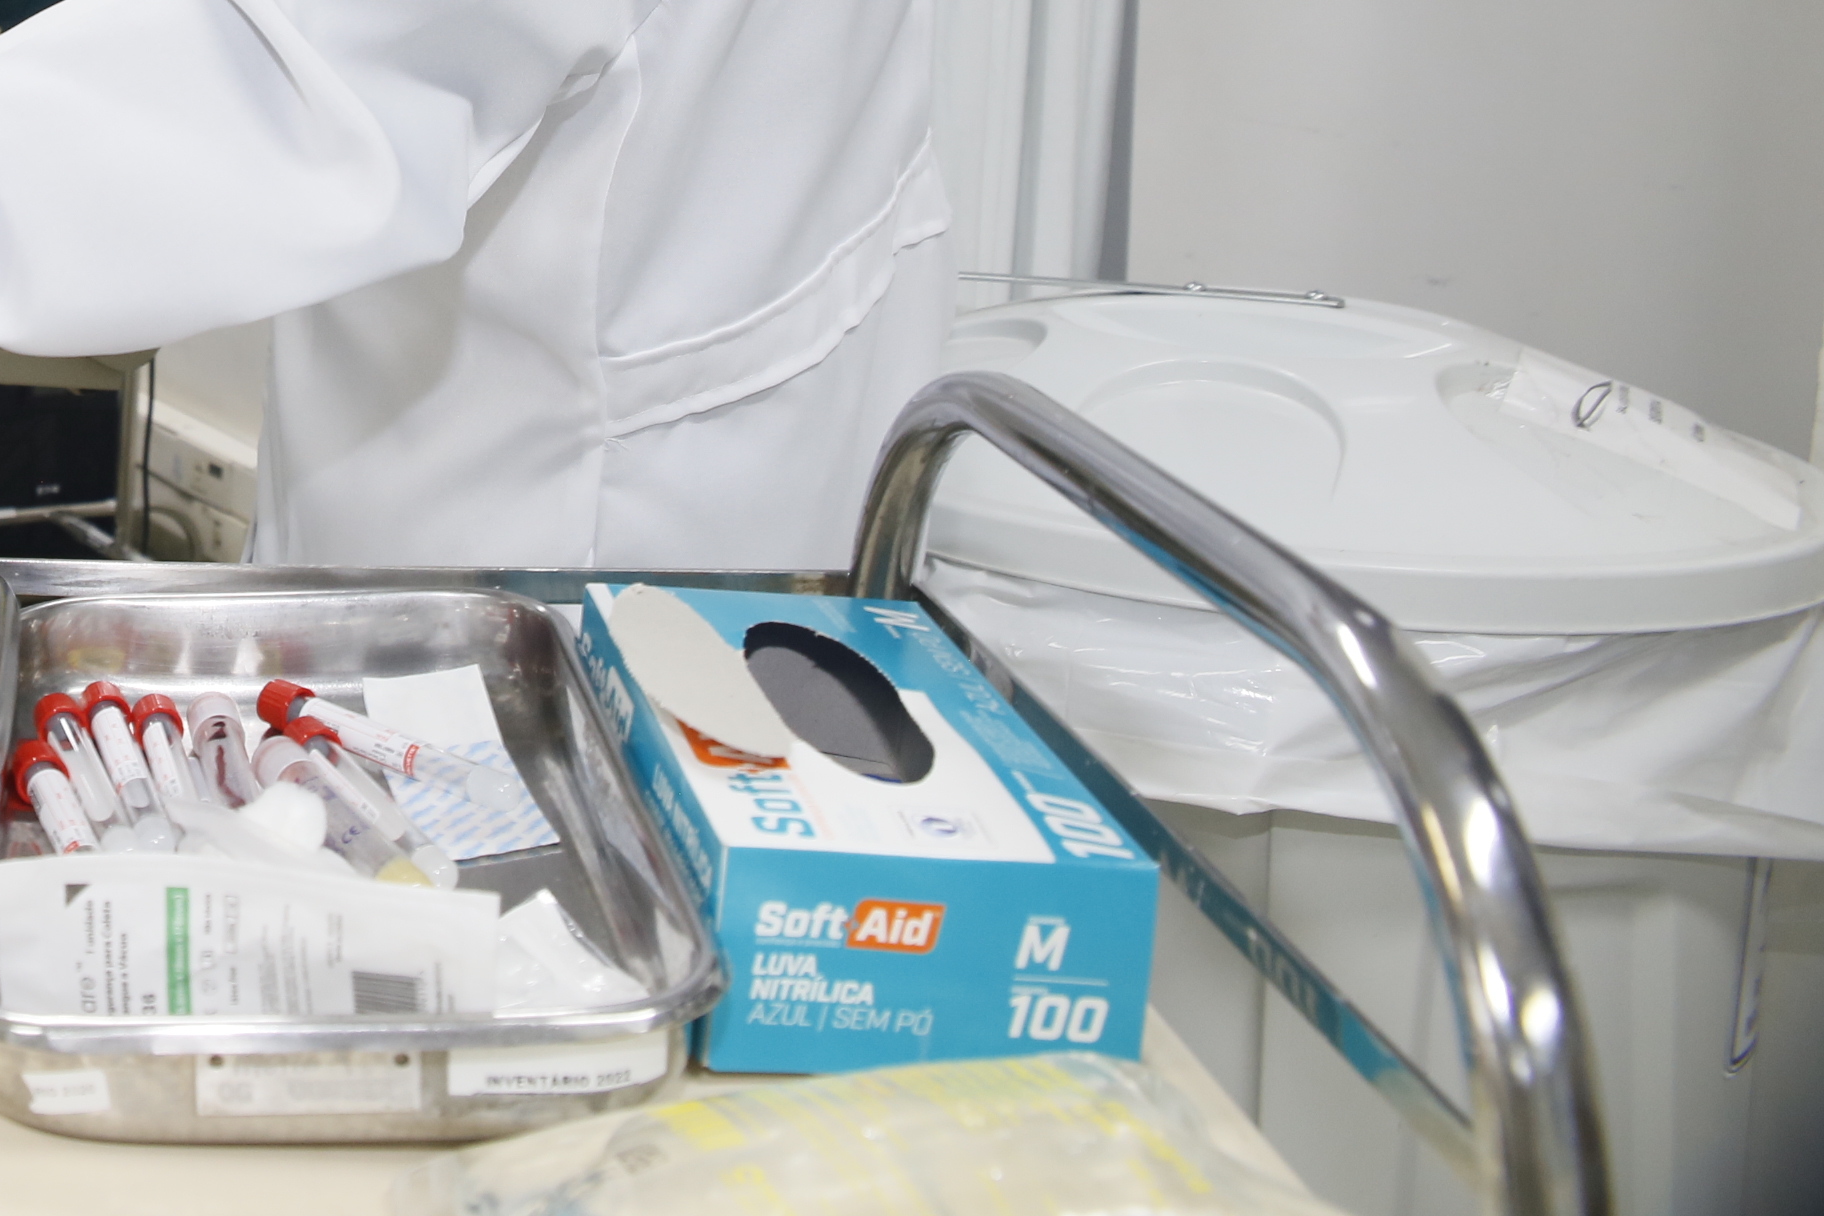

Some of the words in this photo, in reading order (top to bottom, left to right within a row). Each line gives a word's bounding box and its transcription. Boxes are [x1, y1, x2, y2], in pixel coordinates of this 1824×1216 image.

[727, 772, 816, 838] Soft
[1026, 791, 1135, 860] 100
[754, 900, 847, 941] Soft
[855, 907, 934, 947] Aid
[1014, 923, 1071, 972] M
[750, 952, 818, 977] LUVA
[749, 972, 875, 1006] NITRÍLICA
[747, 1004, 813, 1028] AZUL
[831, 1006, 892, 1032] SEM
[893, 1007, 934, 1036] PÓ
[1007, 993, 1110, 1044] 100
